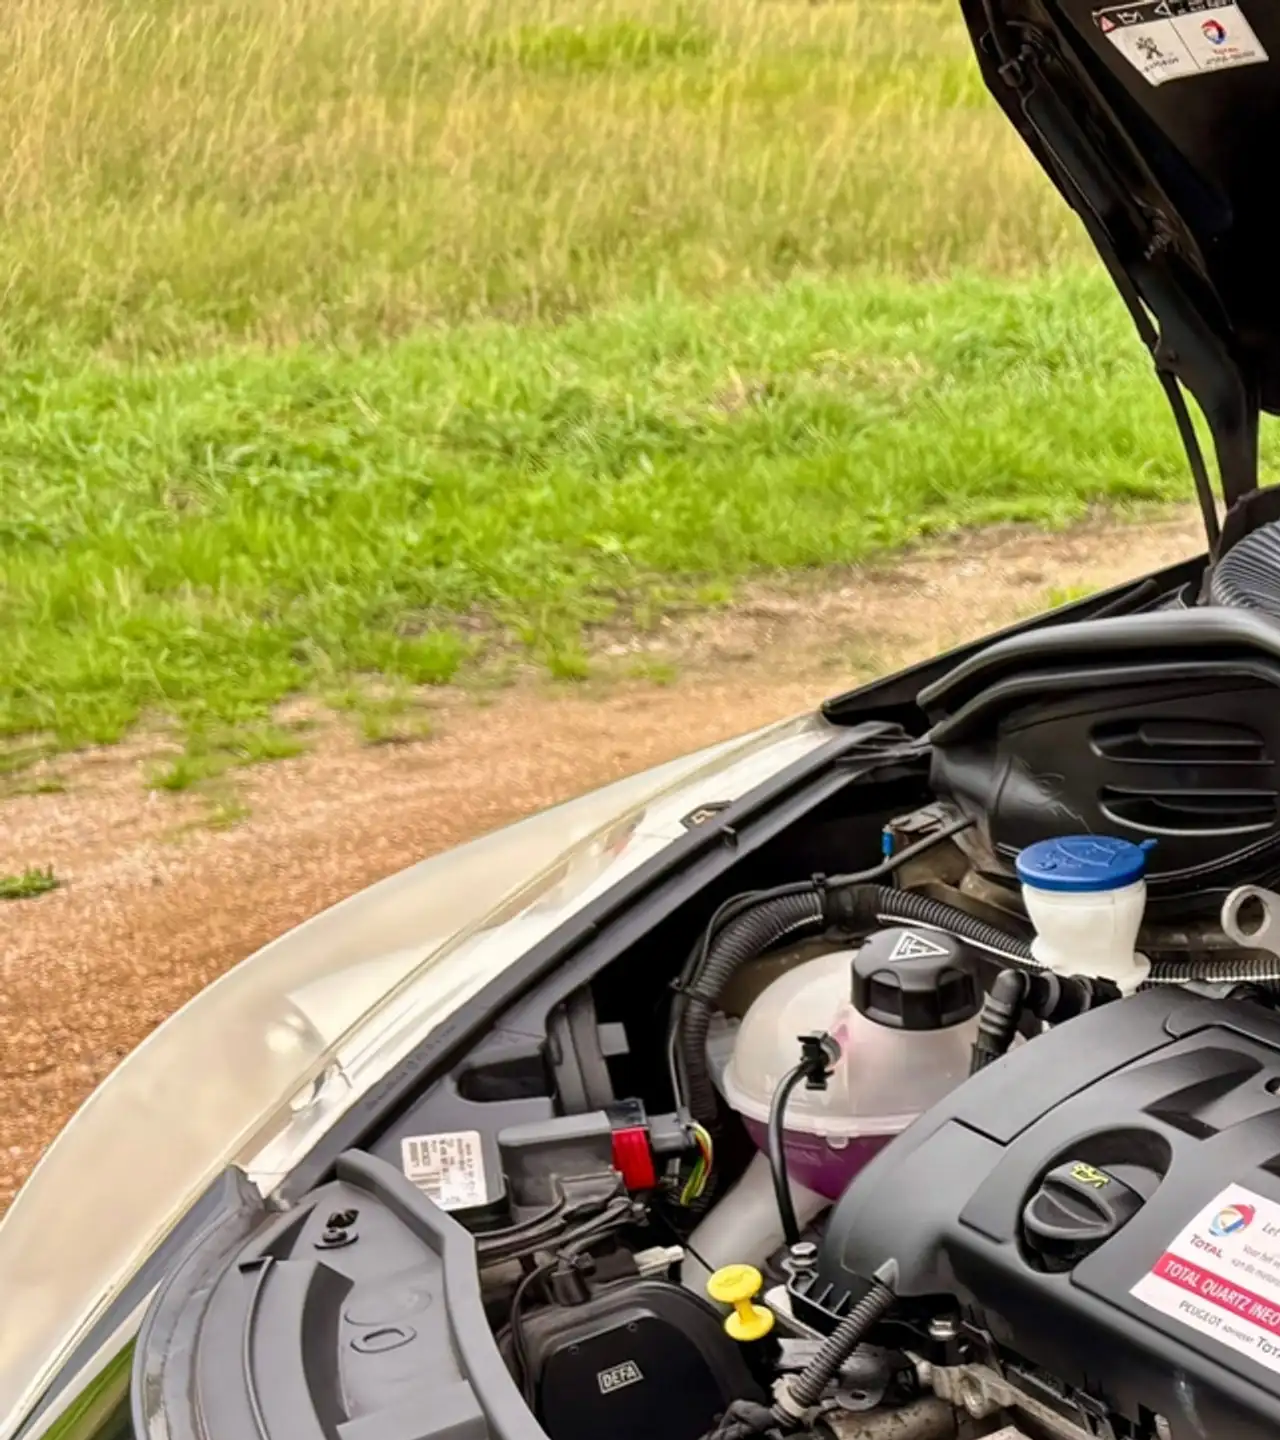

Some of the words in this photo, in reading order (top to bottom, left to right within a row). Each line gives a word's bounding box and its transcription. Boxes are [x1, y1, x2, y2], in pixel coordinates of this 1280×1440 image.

[1189, 1233, 1225, 1258] TOTAL
[1164, 1260, 1201, 1288] TOTAL
[1200, 1277, 1252, 1311] QUARTZ
[1178, 1299, 1224, 1328] PEUGEOT
[601, 1365, 638, 1389] DEFA
